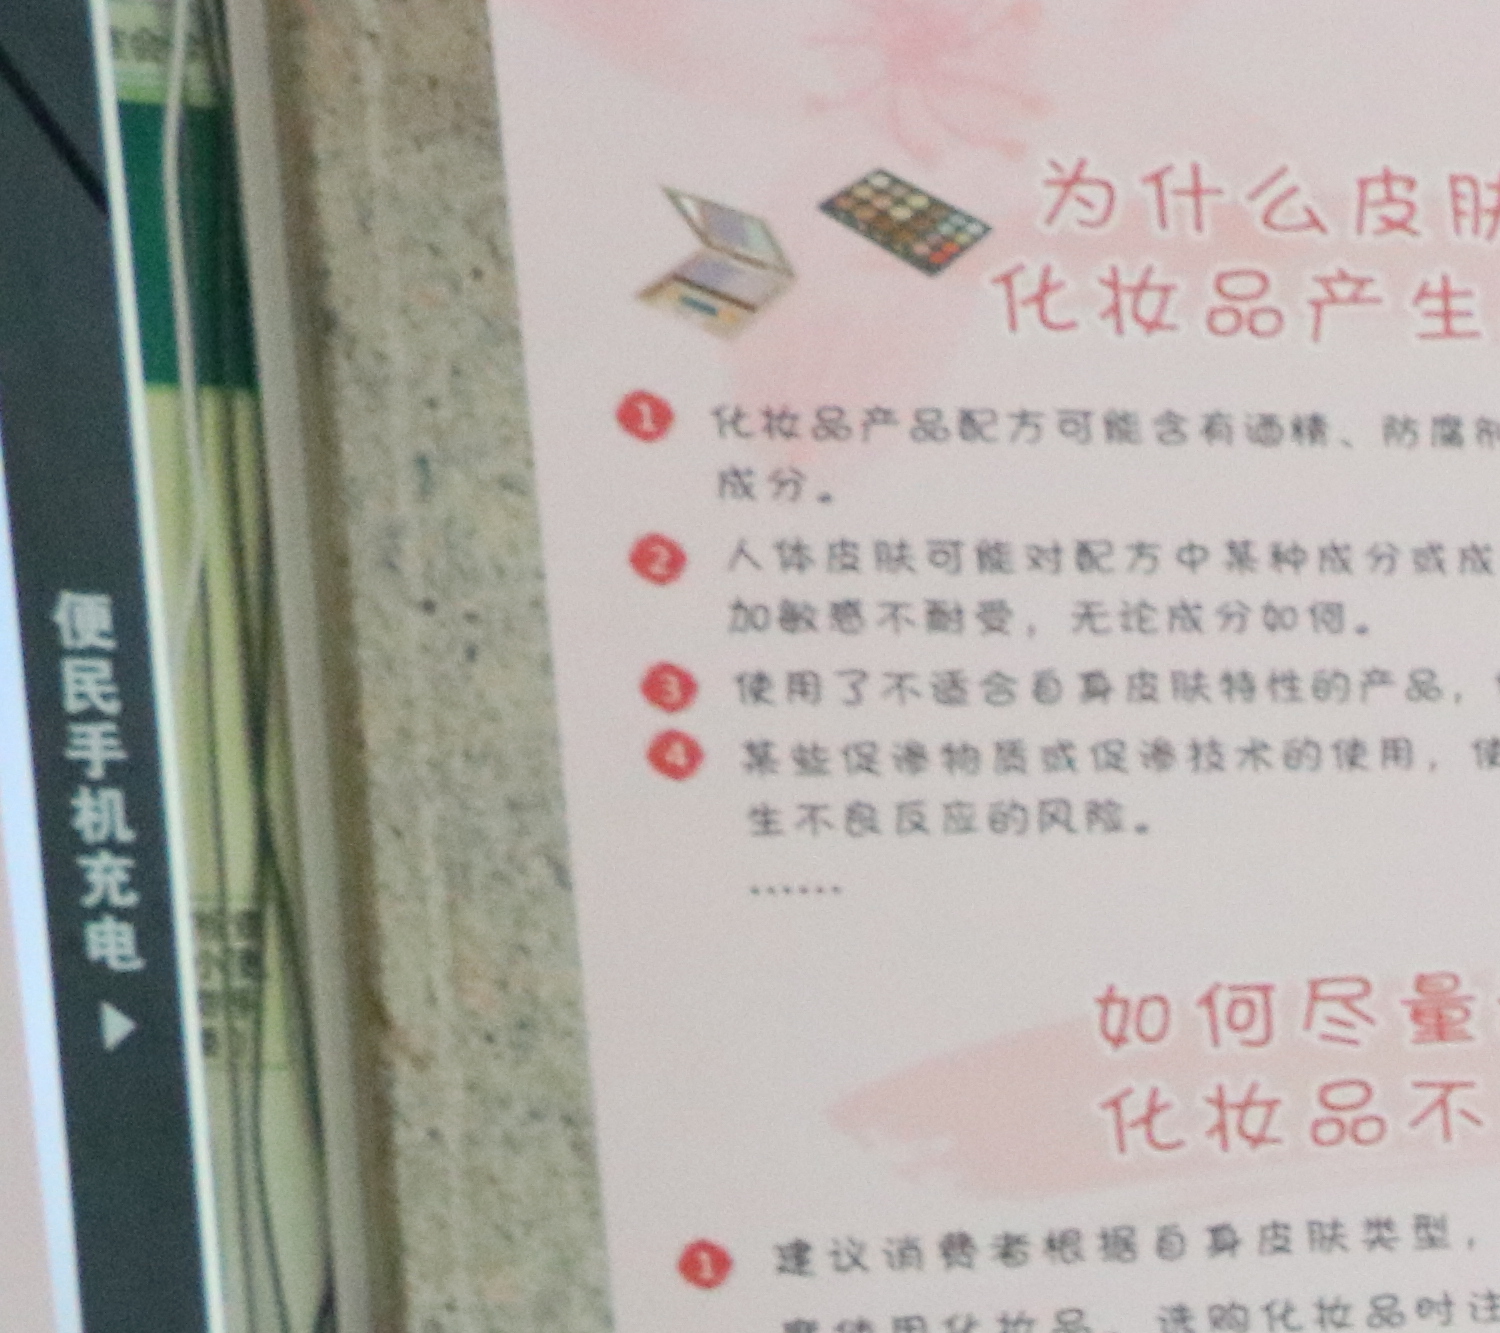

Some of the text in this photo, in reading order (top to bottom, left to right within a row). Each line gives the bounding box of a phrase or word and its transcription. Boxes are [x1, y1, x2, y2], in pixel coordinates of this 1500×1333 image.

[717, 465, 833, 504] 成分。
[51, 590, 147, 973] 便民手机充电
[749, 799, 1151, 838] 生不良反应的风险。
